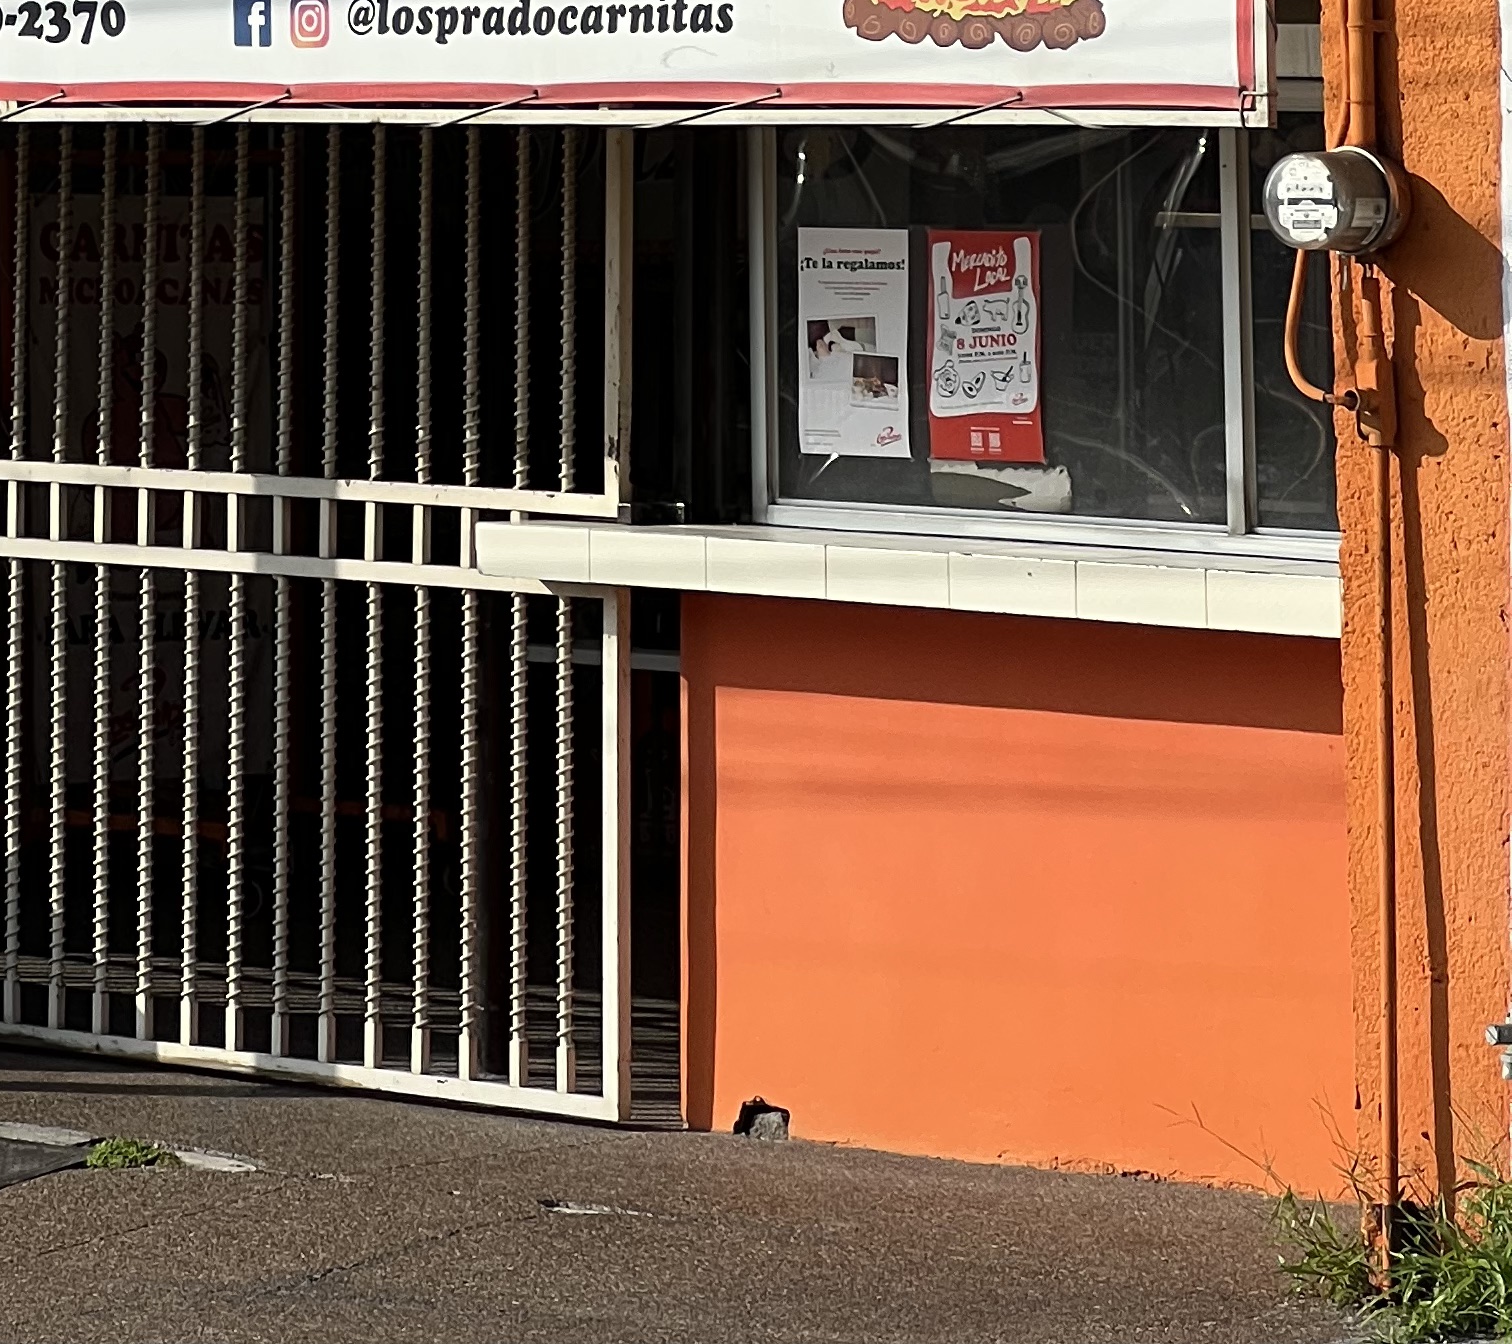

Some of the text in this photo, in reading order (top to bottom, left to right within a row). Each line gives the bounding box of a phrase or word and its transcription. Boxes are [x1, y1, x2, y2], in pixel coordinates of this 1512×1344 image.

[822, 257, 833, 269] la
[956, 333, 1017, 350] 8 JUNIO
